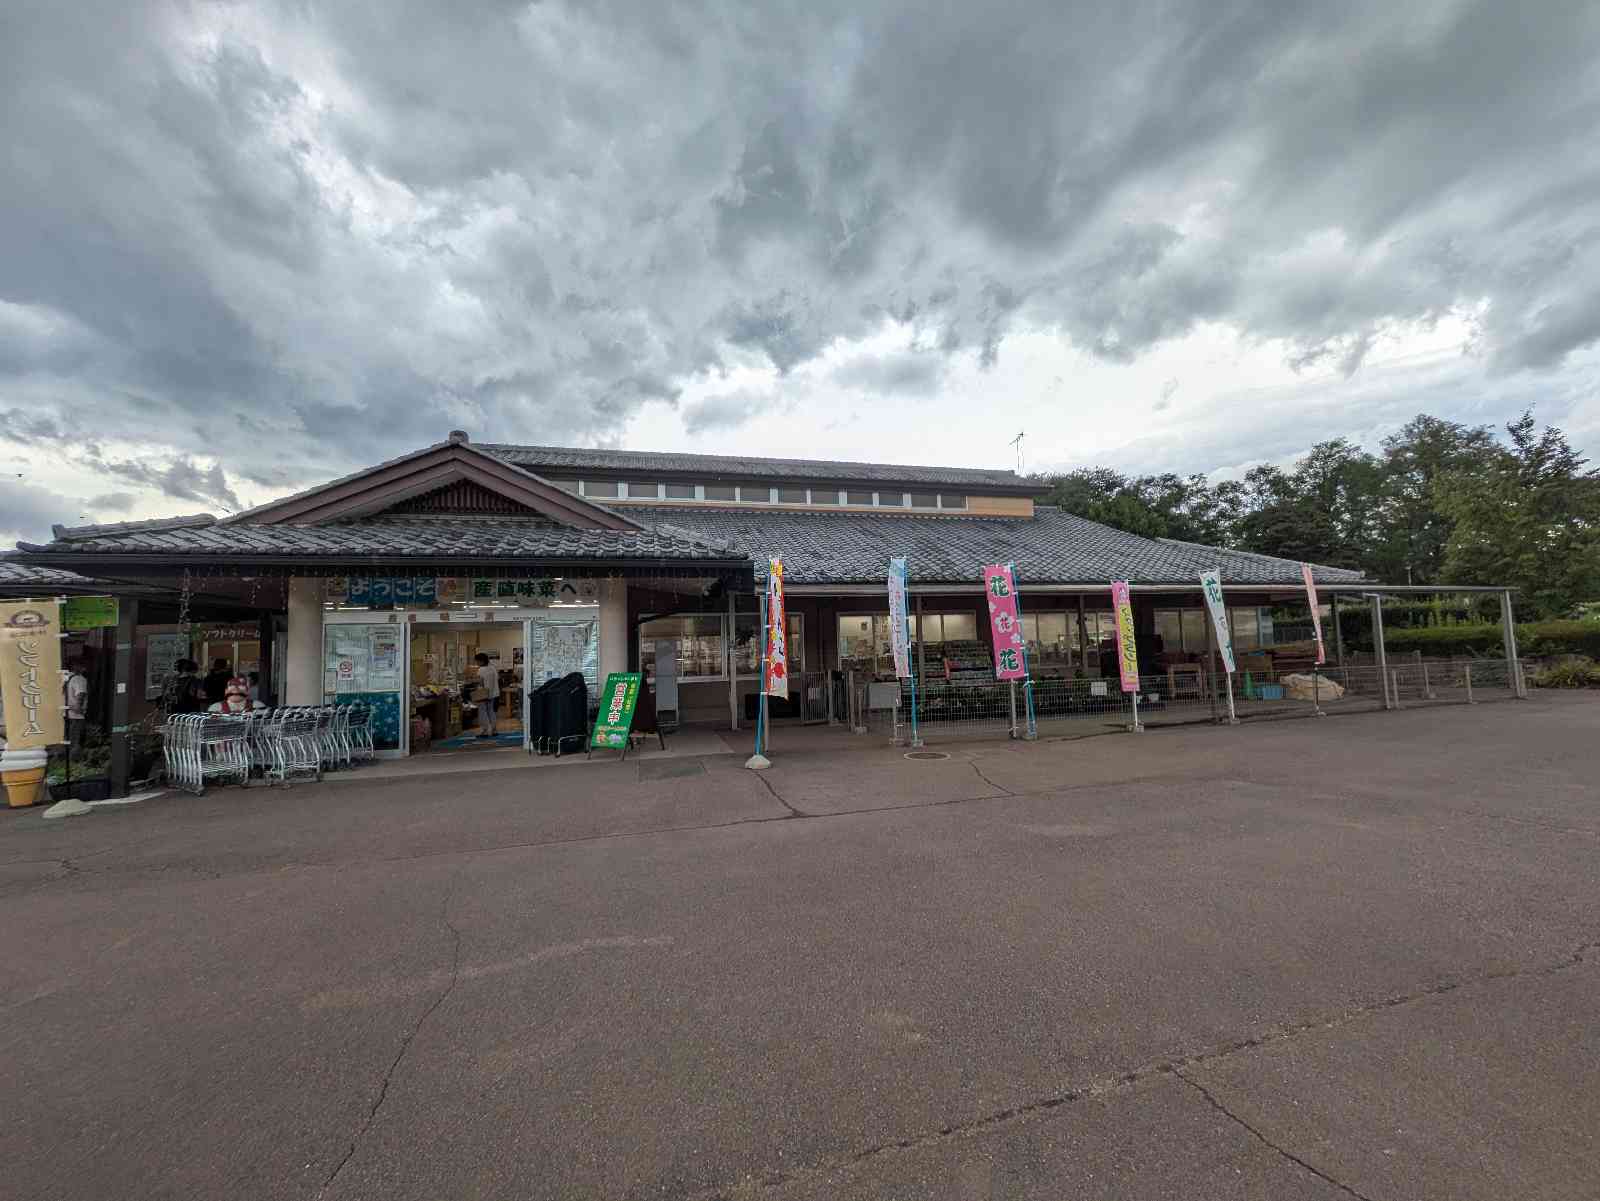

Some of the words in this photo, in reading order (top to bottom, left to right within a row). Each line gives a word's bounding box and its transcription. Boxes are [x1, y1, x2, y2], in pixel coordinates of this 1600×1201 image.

[351, 577, 435, 596] ようこそ
[474, 580, 577, 597] 産直味菜へ
